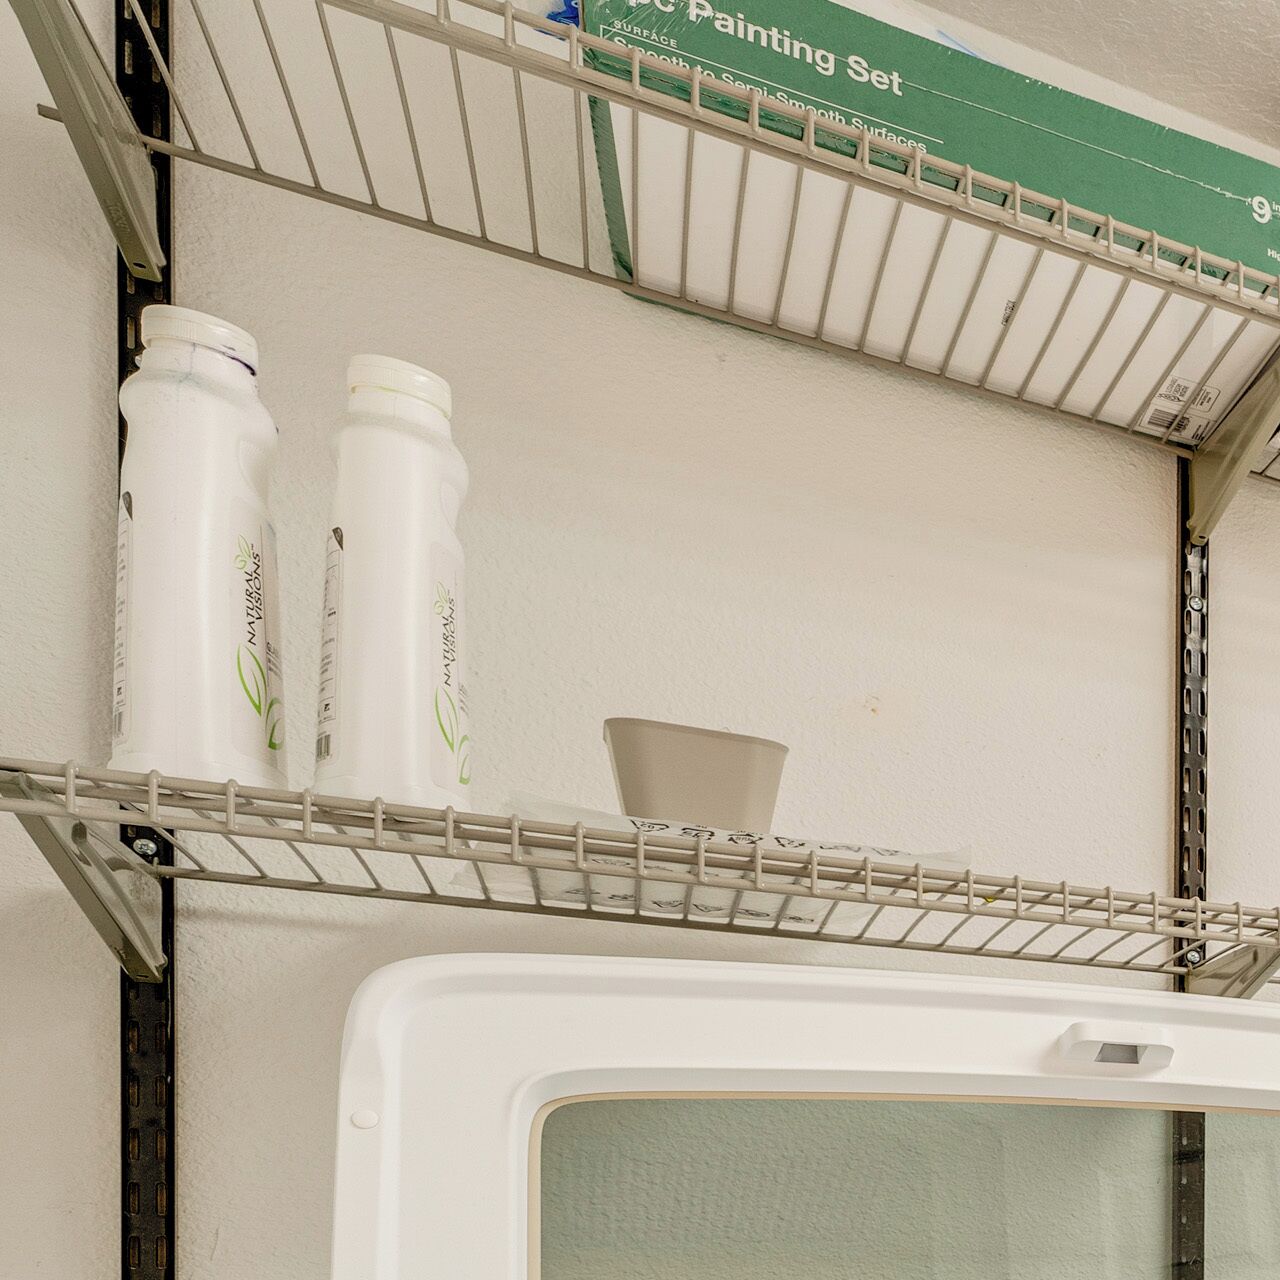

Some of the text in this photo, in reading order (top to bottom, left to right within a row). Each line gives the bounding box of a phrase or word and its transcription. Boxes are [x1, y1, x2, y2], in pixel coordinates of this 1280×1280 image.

[613, 20, 678, 48] SURFACE
[688, 1, 836, 76] Painting
[847, 56, 903, 97] Set
[1252, 196, 1272, 224] 9
[245, 570, 257, 646] NATURAL
[441, 615, 452, 687] NATURAL
